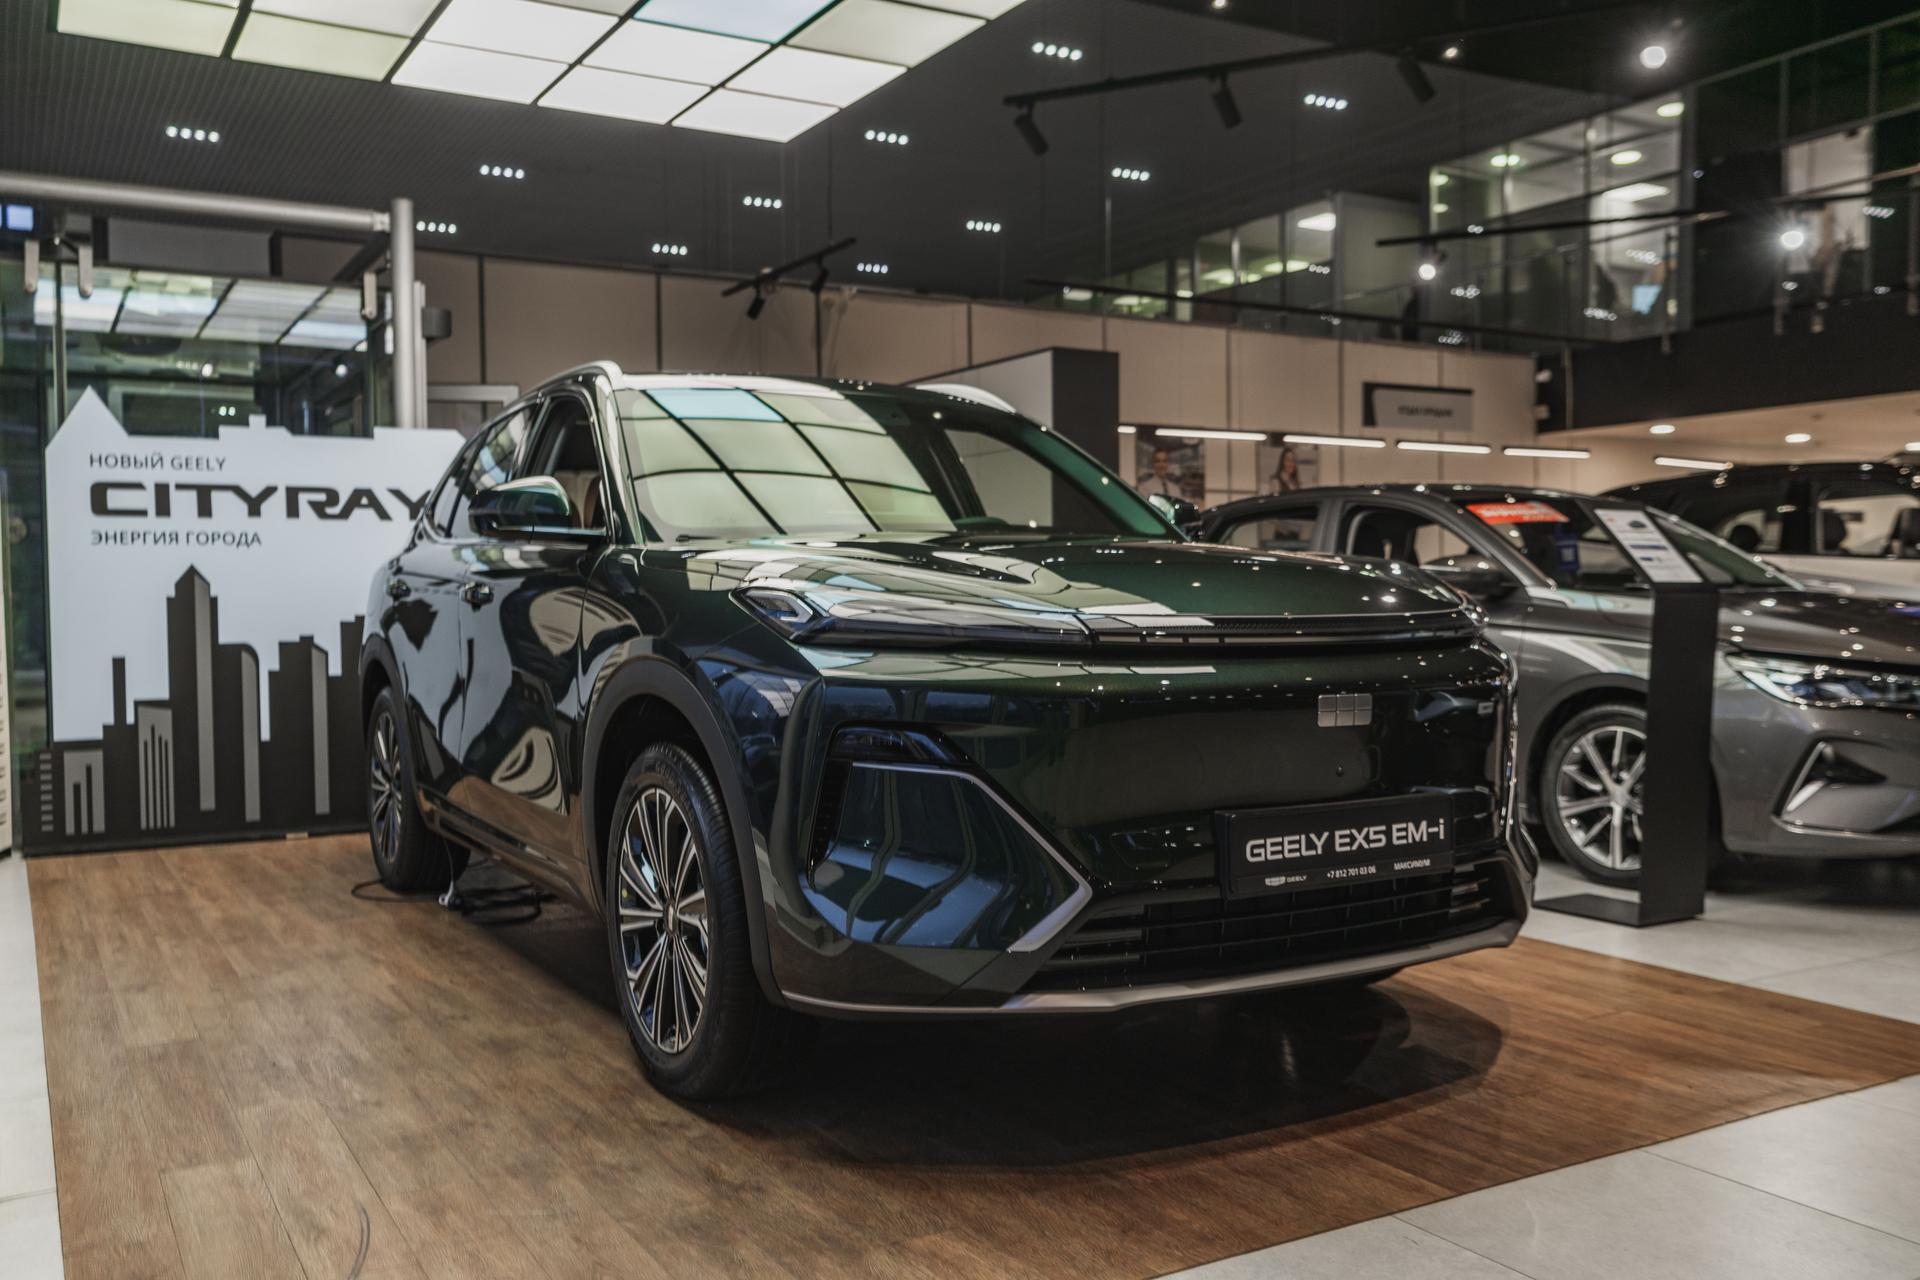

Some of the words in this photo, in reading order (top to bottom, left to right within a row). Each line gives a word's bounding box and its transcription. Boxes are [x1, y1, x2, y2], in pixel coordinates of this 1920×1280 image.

[89, 452, 164, 470] НОВЫЙ
[170, 456, 226, 472] GEELY
[90, 481, 431, 521] CITYRAY
[91, 530, 179, 546] ЭНЕРГИЯ
[185, 531, 262, 549] ГОРОДА
[1245, 831, 1330, 863] GEELY
[1334, 825, 1387, 853] EX5
[1391, 818, 1445, 846] EM-i
